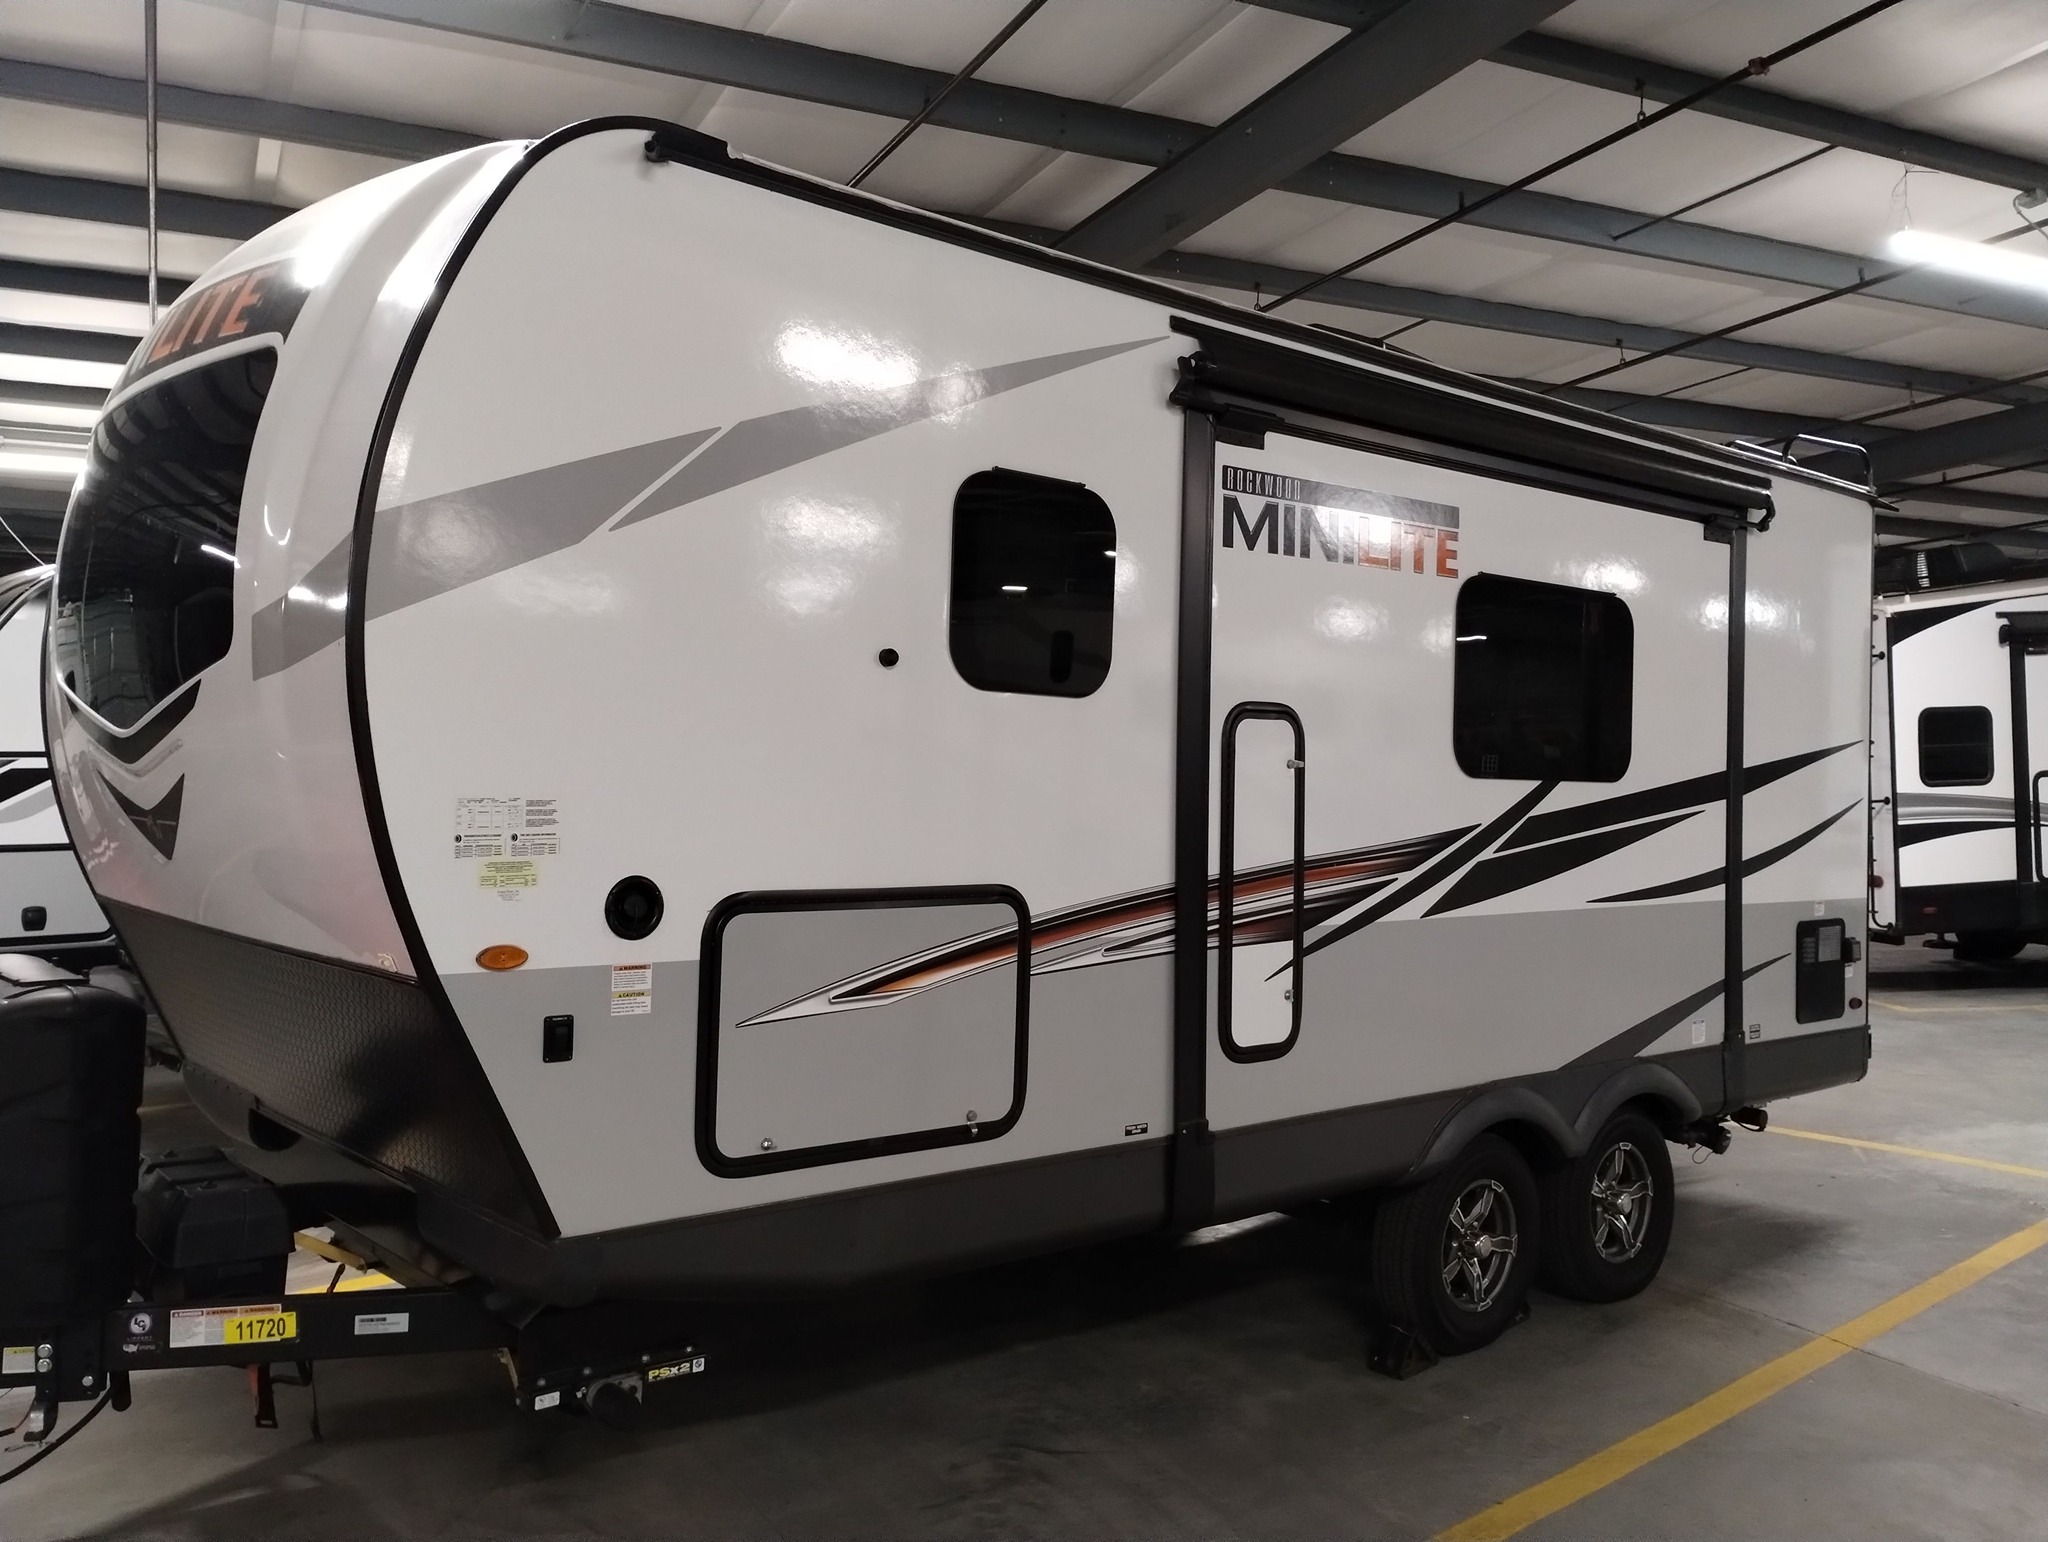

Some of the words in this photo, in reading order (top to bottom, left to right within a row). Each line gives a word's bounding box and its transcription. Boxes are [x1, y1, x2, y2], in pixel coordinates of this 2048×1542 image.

[1226, 467, 1302, 501] ROCKWOOD
[236, 1318, 286, 1340] 11720
[648, 1362, 691, 1380] PSx2
